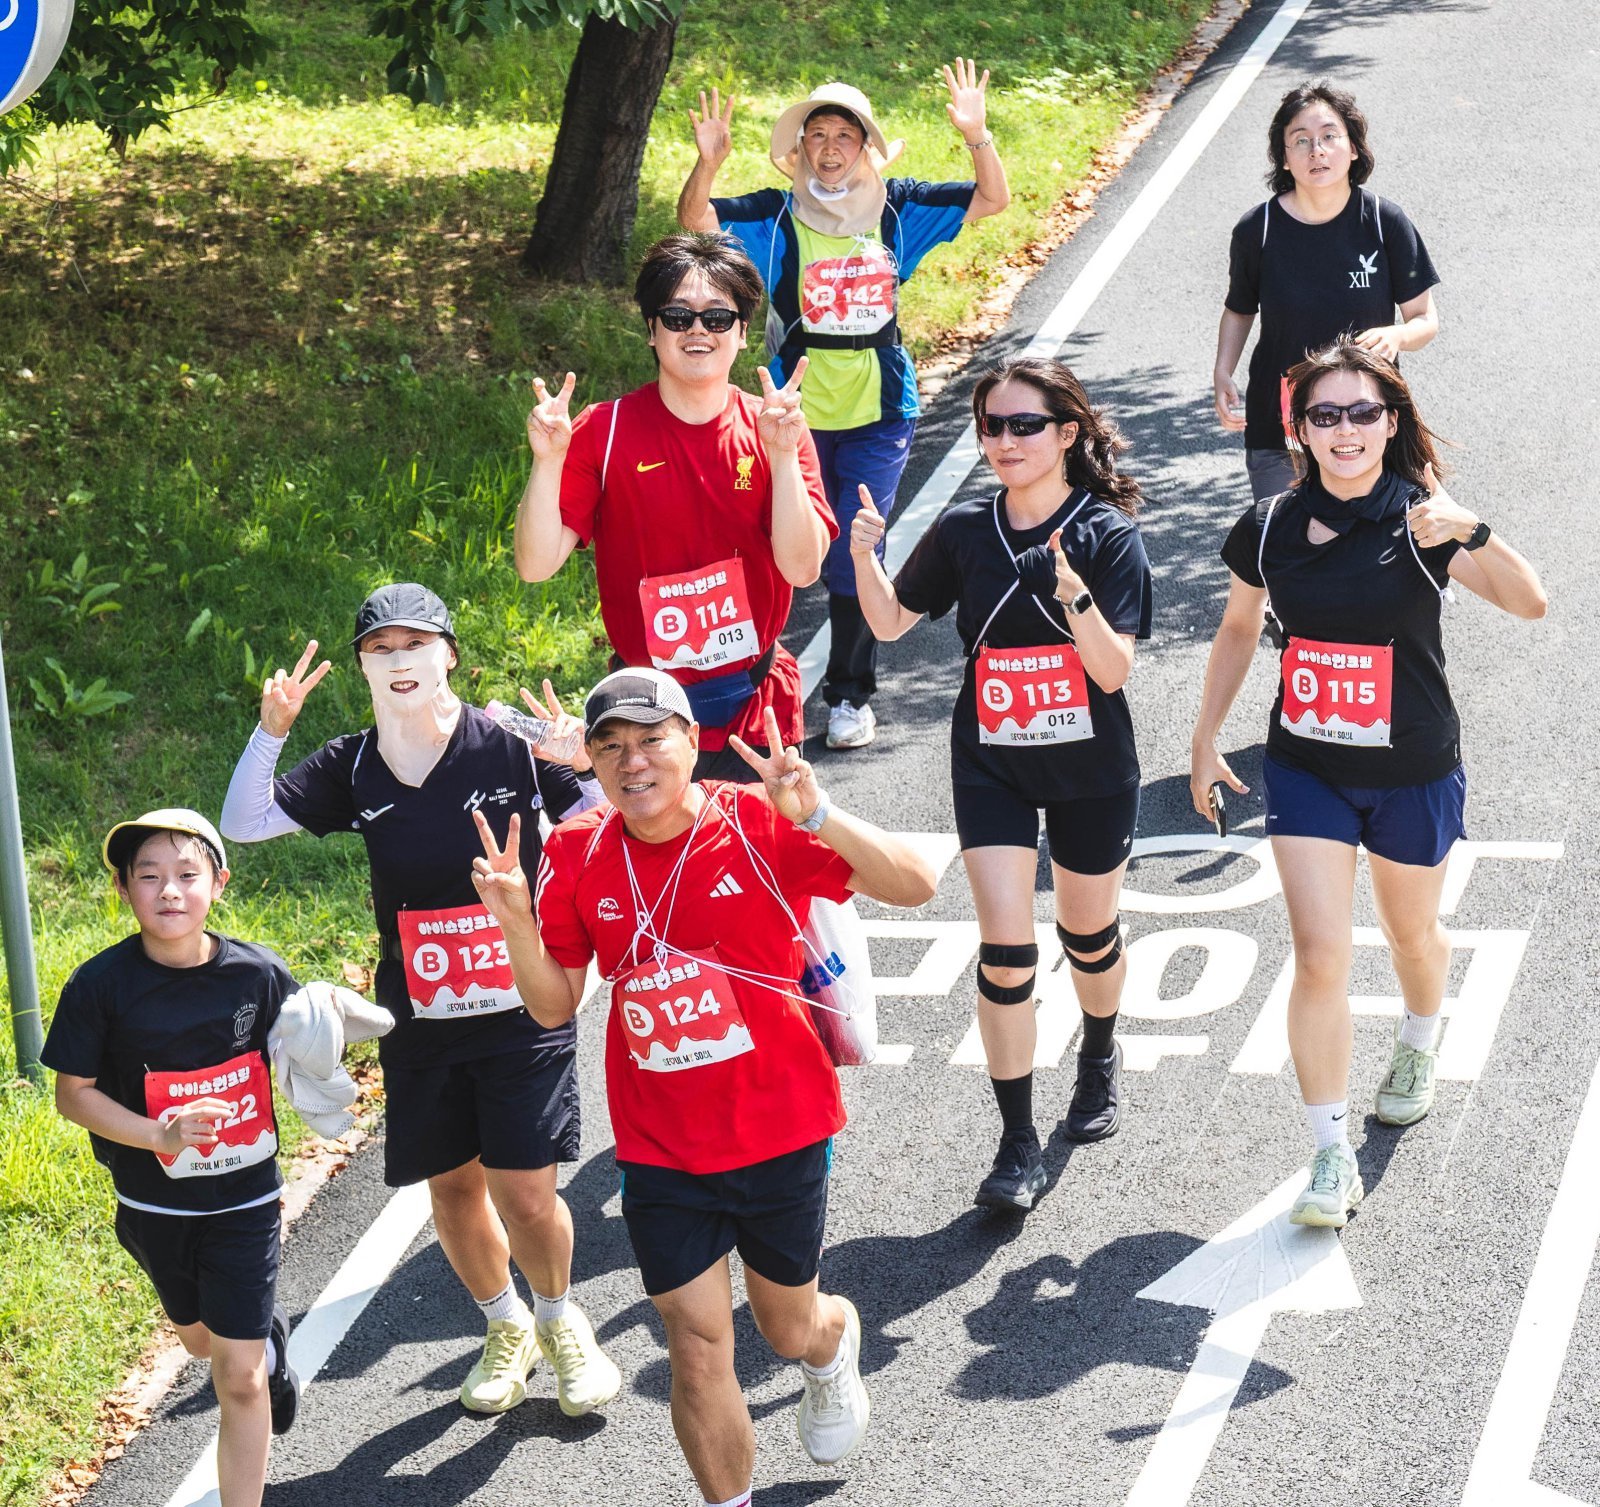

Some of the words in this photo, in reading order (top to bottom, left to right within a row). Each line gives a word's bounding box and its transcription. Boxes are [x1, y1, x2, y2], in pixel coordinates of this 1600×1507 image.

[1348, 271, 1371, 289] XII
[817, 291, 829, 302] B
[843, 284, 883, 305] 142
[857, 308, 877, 319] 034
[659, 571, 727, 598] 아이스런크림
[662, 614, 679, 635] B
[695, 596, 738, 630] 114
[719, 628, 744, 645] 013
[988, 654, 1064, 673] 아이스런크림
[1297, 649, 1373, 670] 아이스런크림
[988, 686, 1005, 705] B
[1022, 679, 1072, 706] 113
[1298, 674, 1312, 695] B
[1327, 680, 1376, 705] 115
[1048, 712, 1076, 727] 012
[422, 951, 440, 973] B
[458, 940, 510, 972] 123
[479, 998, 498, 1009] SOUL
[627, 1008, 646, 1029] B
[658, 988, 721, 1027] 124
[168, 1066, 250, 1098] 아이스런크림
[190, 1161, 212, 1171] SEOUL
[224, 1155, 242, 1167] SOUL
